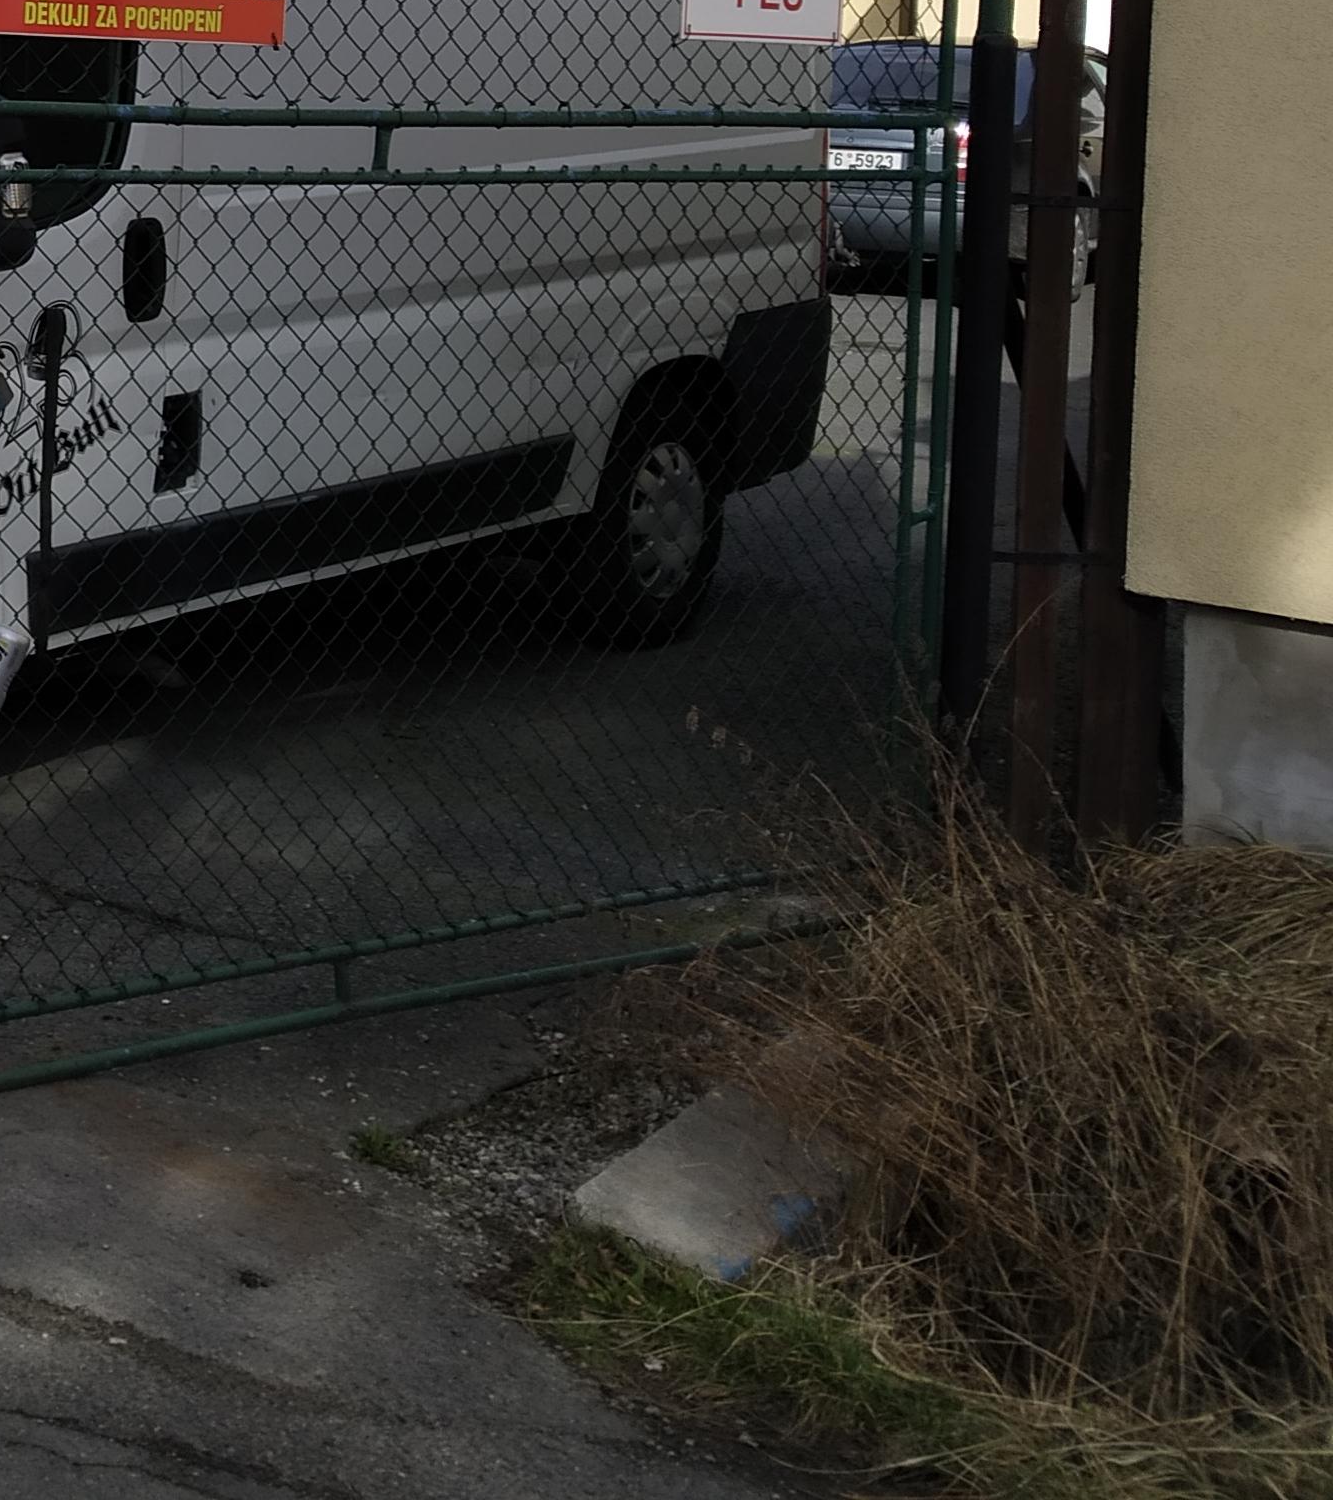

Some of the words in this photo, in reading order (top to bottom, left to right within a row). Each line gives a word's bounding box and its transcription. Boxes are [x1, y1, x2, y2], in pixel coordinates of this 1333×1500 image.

[95, 7, 118, 28] ZA
[124, 4, 224, 33] POCHOPENÍ
[855, 153, 894, 169] 5923
